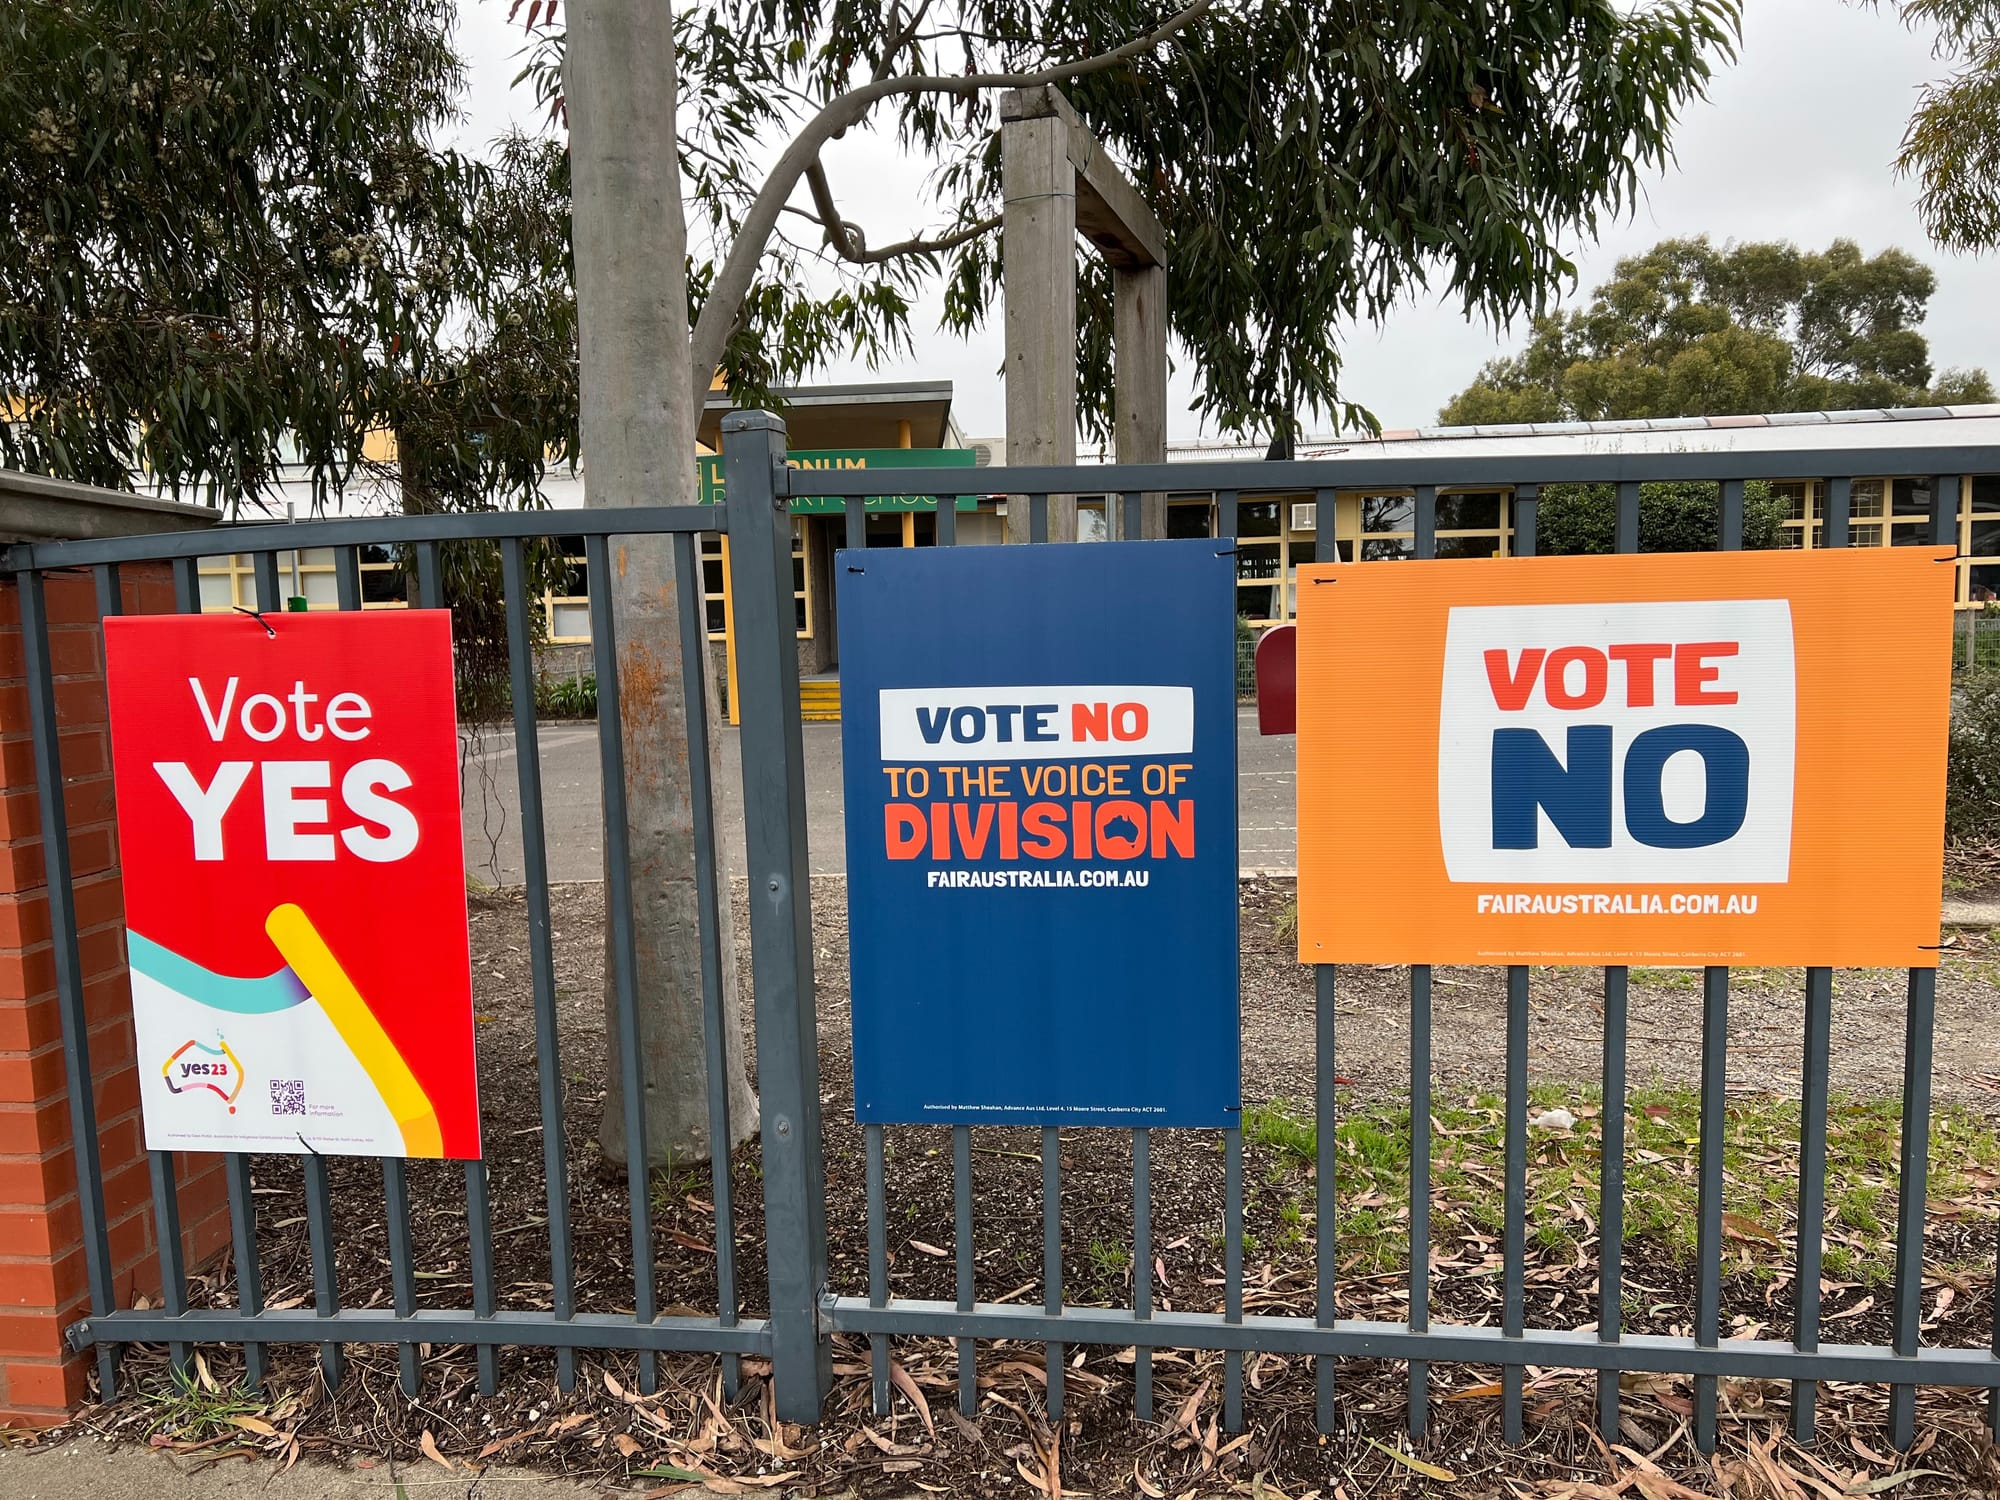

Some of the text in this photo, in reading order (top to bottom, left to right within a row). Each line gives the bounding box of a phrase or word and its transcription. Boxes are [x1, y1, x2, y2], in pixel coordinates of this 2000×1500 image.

[1484, 642, 1739, 711] VOTE
[189, 677, 372, 742] Vote
[916, 703, 1148, 744] VOTE NO
[883, 764, 1193, 797] TO THE VOICE OF
[1491, 724, 1749, 850] NO
[153, 759, 419, 862] YES
[885, 799, 1195, 859] DIVISION
[928, 870, 1148, 887] FAIRAUSTRALIA.COM.AU
[1478, 894, 1757, 914] FAIRAUSTRALIA.COM.AU
[180, 1062, 228, 1078] yes23
